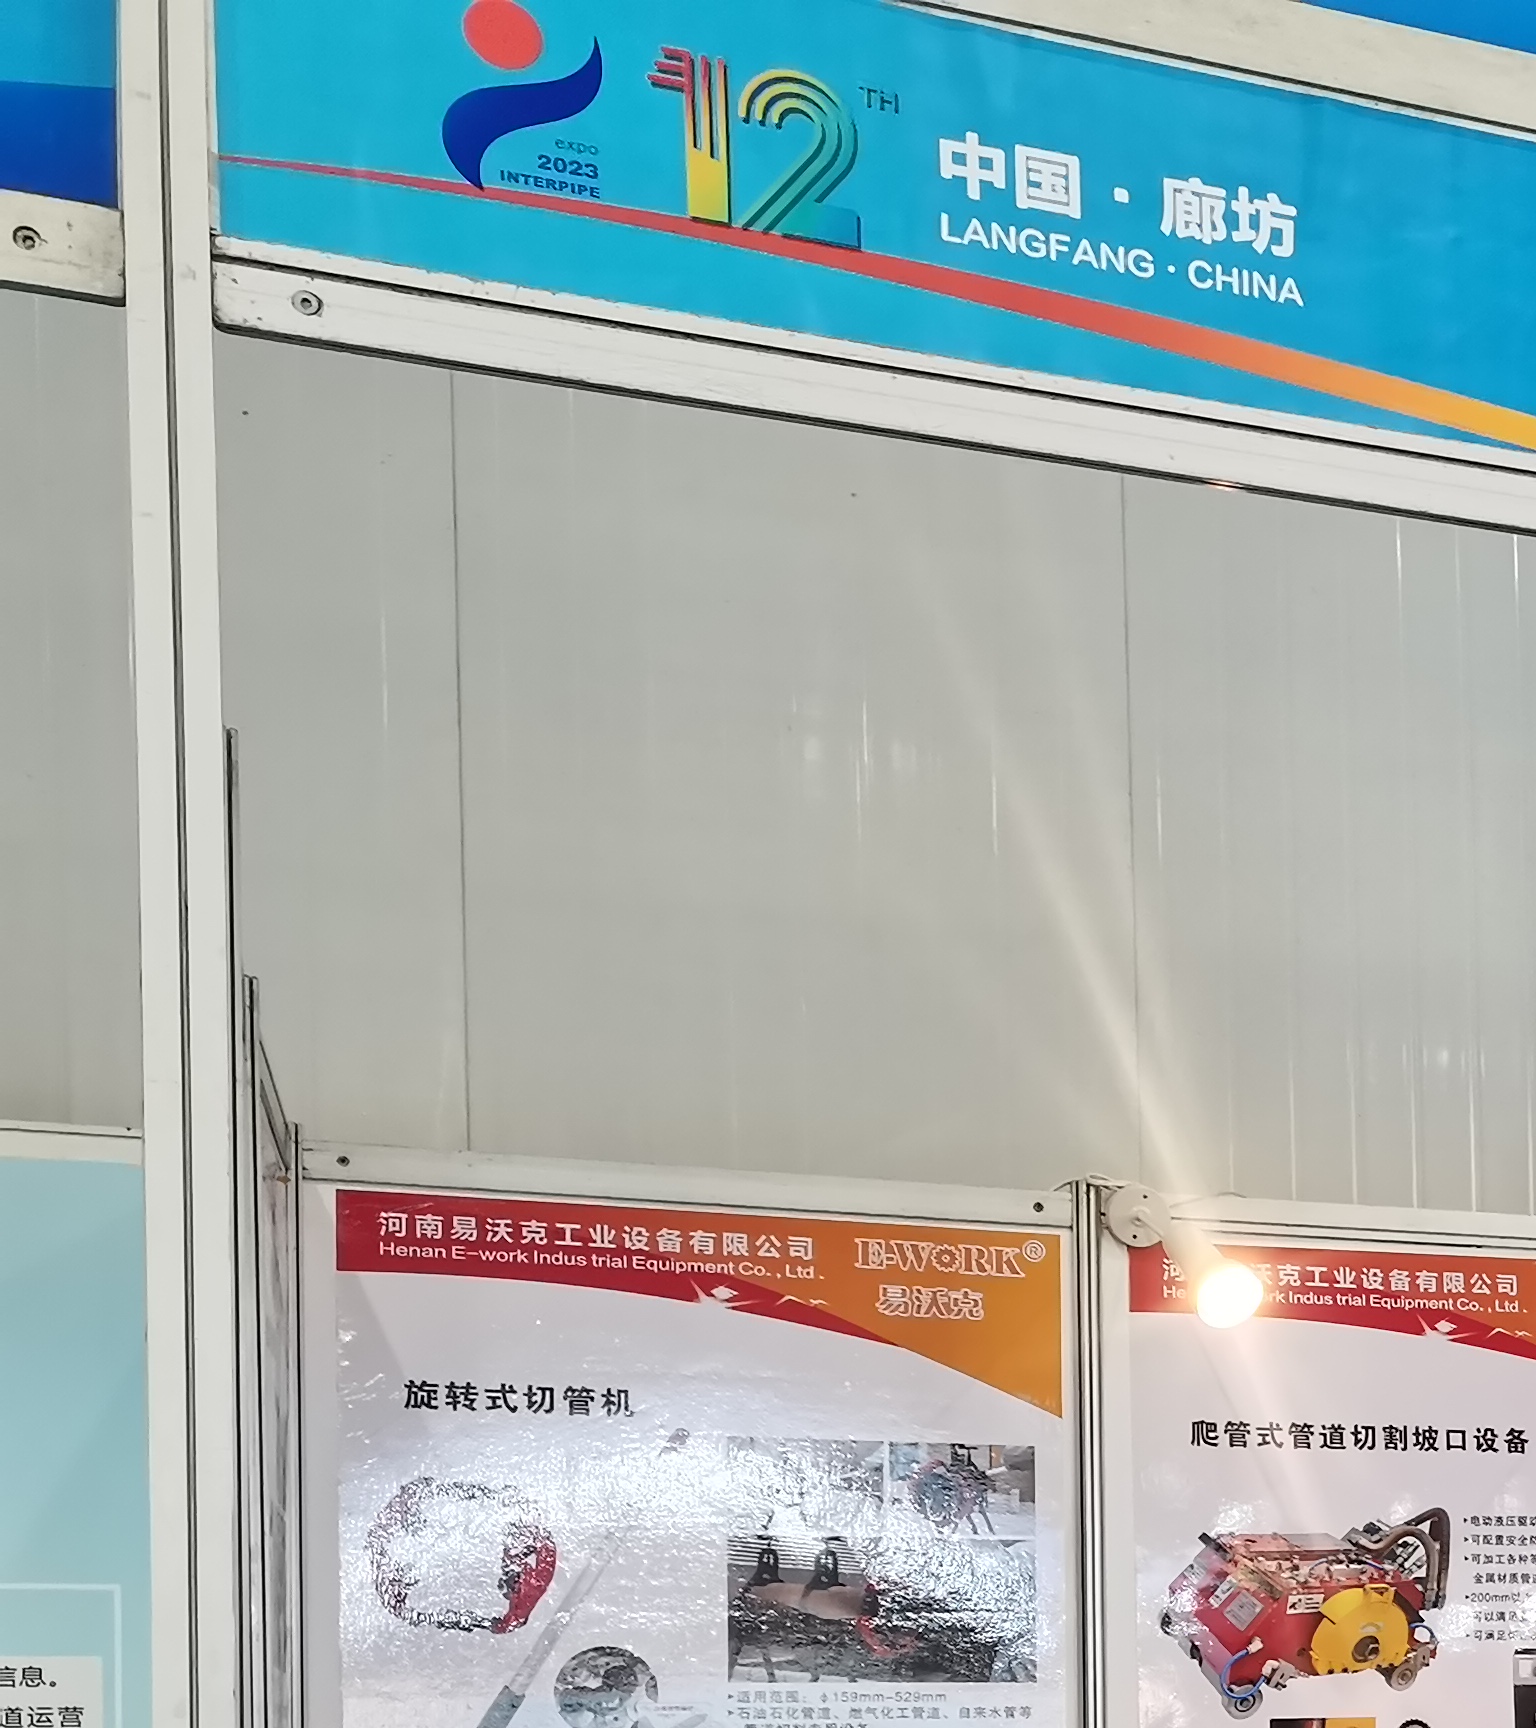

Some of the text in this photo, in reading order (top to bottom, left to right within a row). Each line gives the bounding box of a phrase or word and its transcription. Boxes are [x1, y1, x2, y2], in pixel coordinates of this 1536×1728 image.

[554, 138, 598, 156] expo
[500, 169, 600, 199] INTERPIPE
[537, 153, 599, 180] 2023
[940, 212, 1305, 308] LANGFANG CHINA
[377, 1212, 816, 1261] 河南易沃克工业设备有限公司
[378, 1241, 447, 1260] Henan
[451, 1246, 529, 1265] E-work
[532, 1250, 587, 1268] Indus
[590, 1253, 628, 1272] trial
[631, 1256, 735, 1280] Equipment
[876, 1285, 985, 1320] 易沃克
[1288, 1291, 1333, 1306] Indus
[1337, 1293, 1367, 1307] trial
[1369, 1295, 1454, 1312] Equipment
[402, 1379, 636, 1418] 旋转式切管机
[1190, 1419, 1530, 1455] 爬管式管道切割坡口设备
[0, 1706, 84, 1728] 道运营
